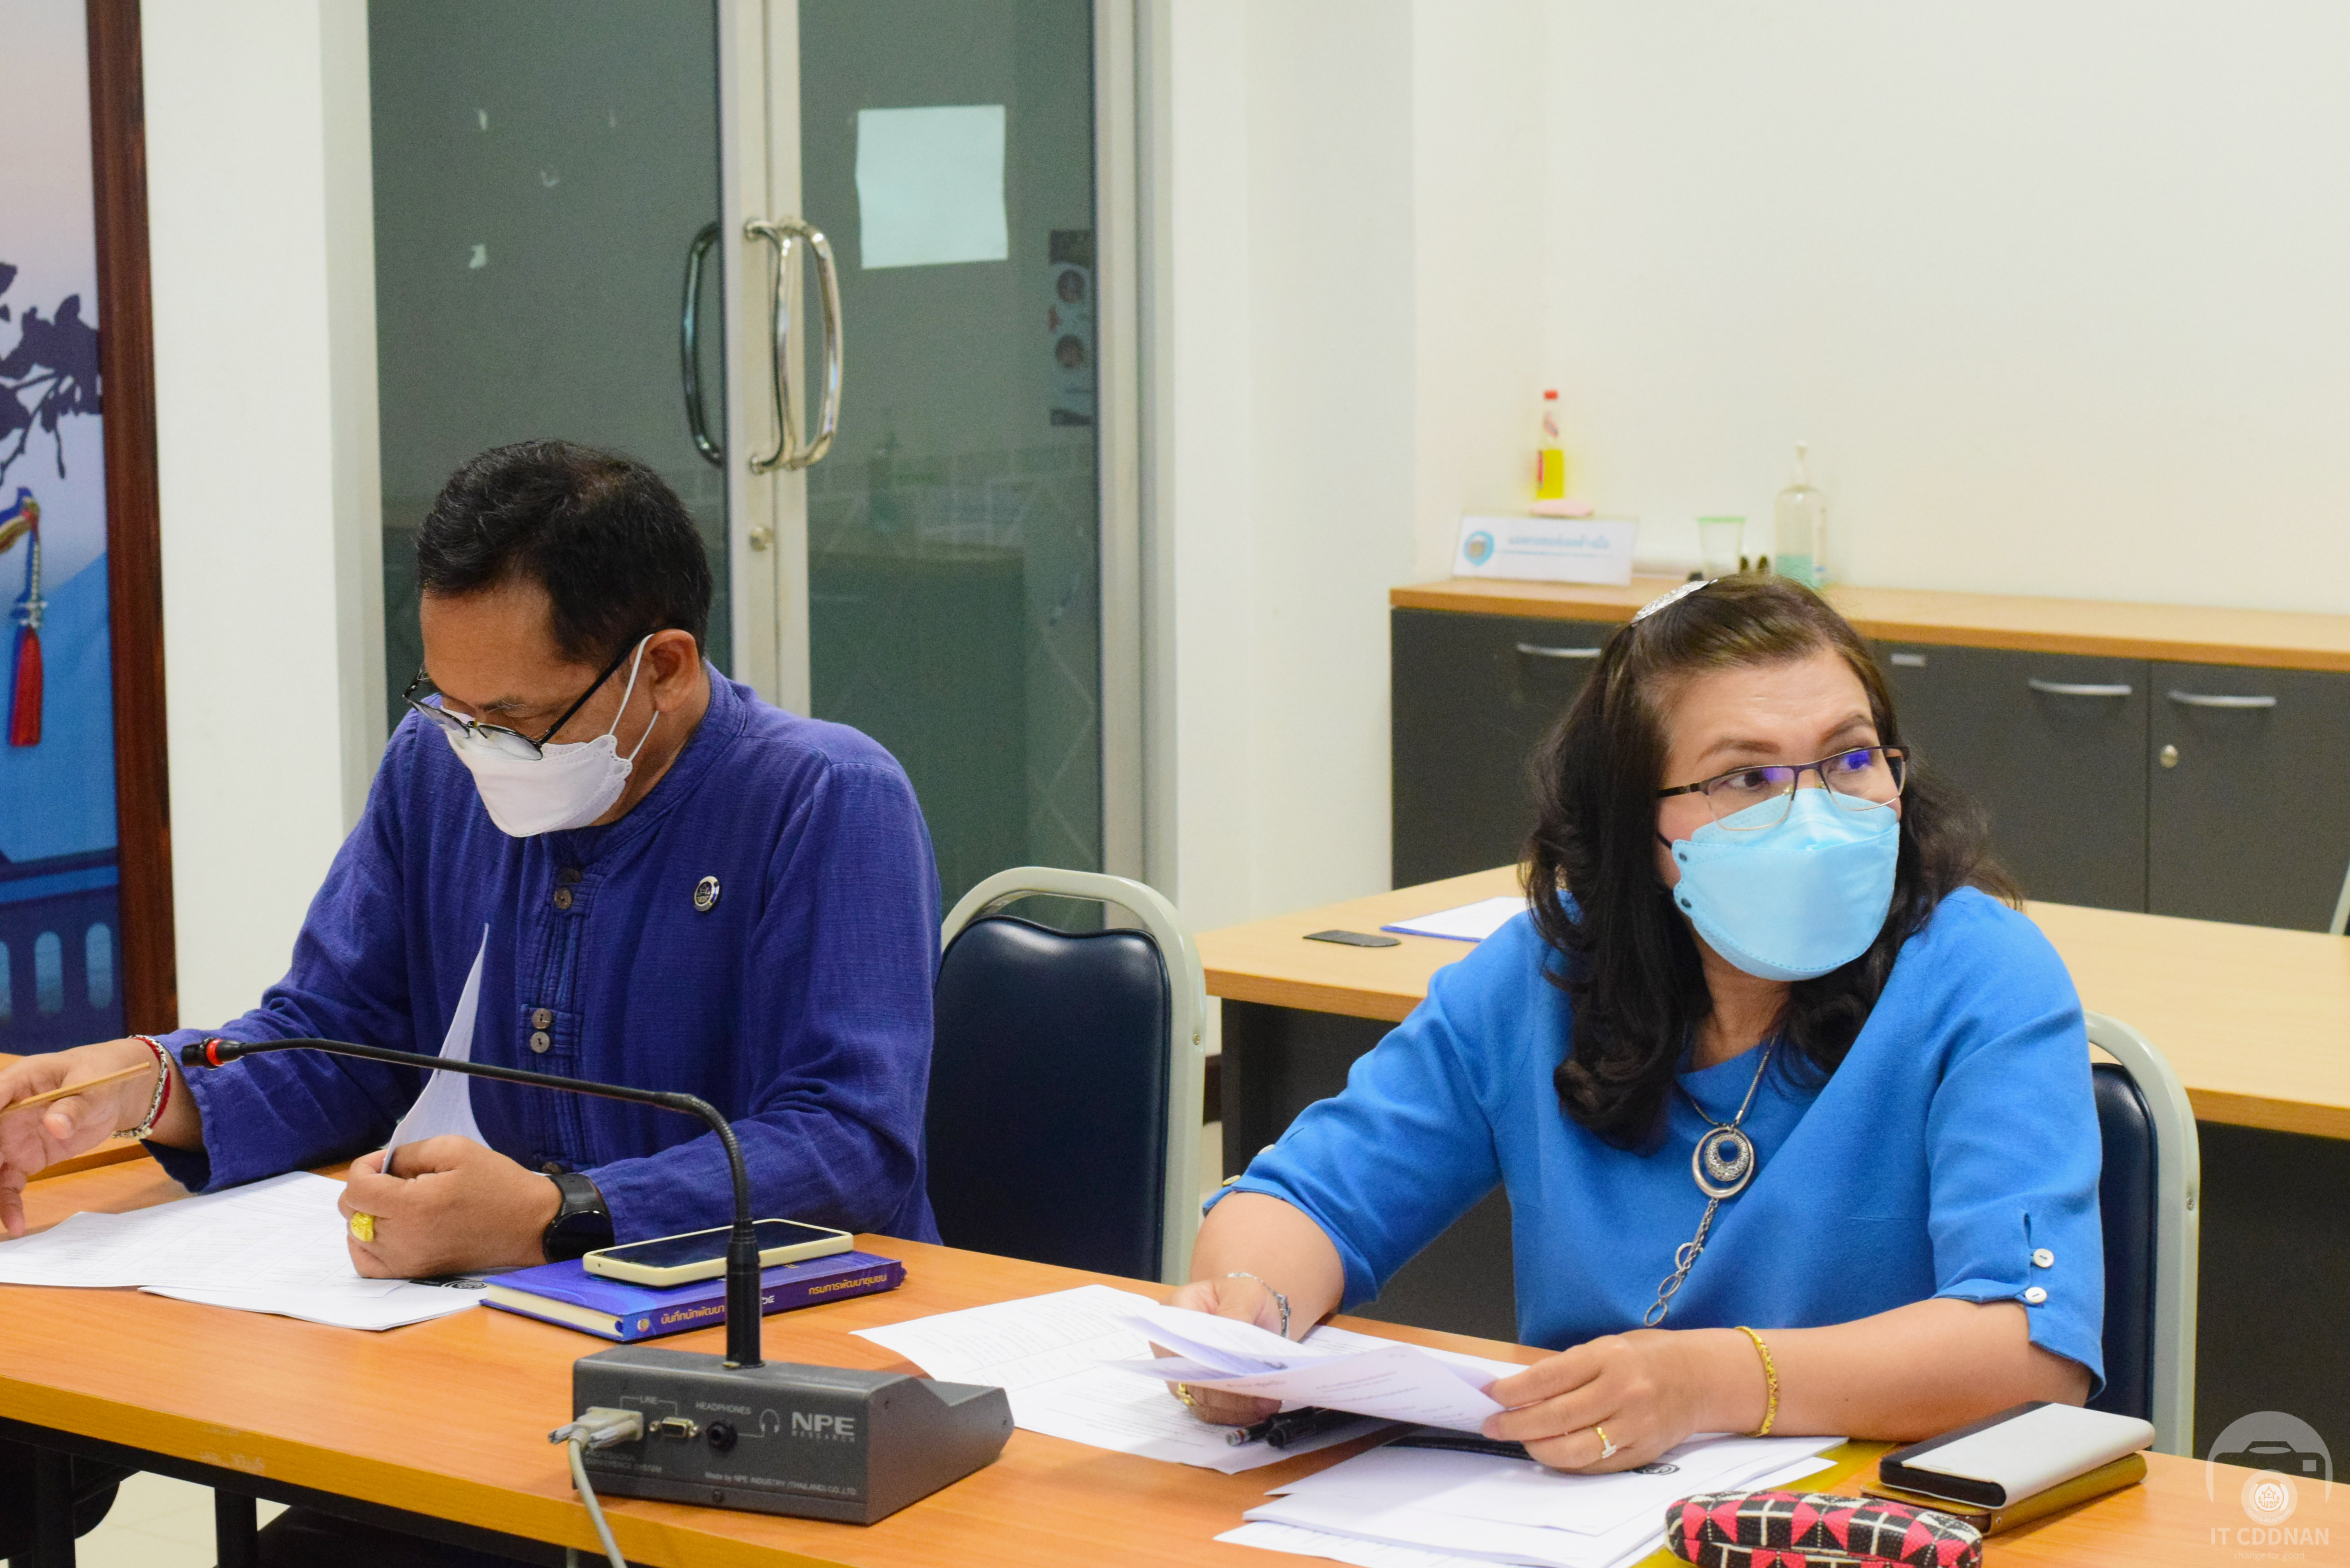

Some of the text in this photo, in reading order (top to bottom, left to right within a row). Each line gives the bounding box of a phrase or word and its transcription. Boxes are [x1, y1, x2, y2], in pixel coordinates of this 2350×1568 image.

[808, 1274, 888, 1295] กรมการพัฒนาชุมชน
[695, 1401, 752, 1415] HEADPHONES
[791, 1411, 856, 1436] NPE
